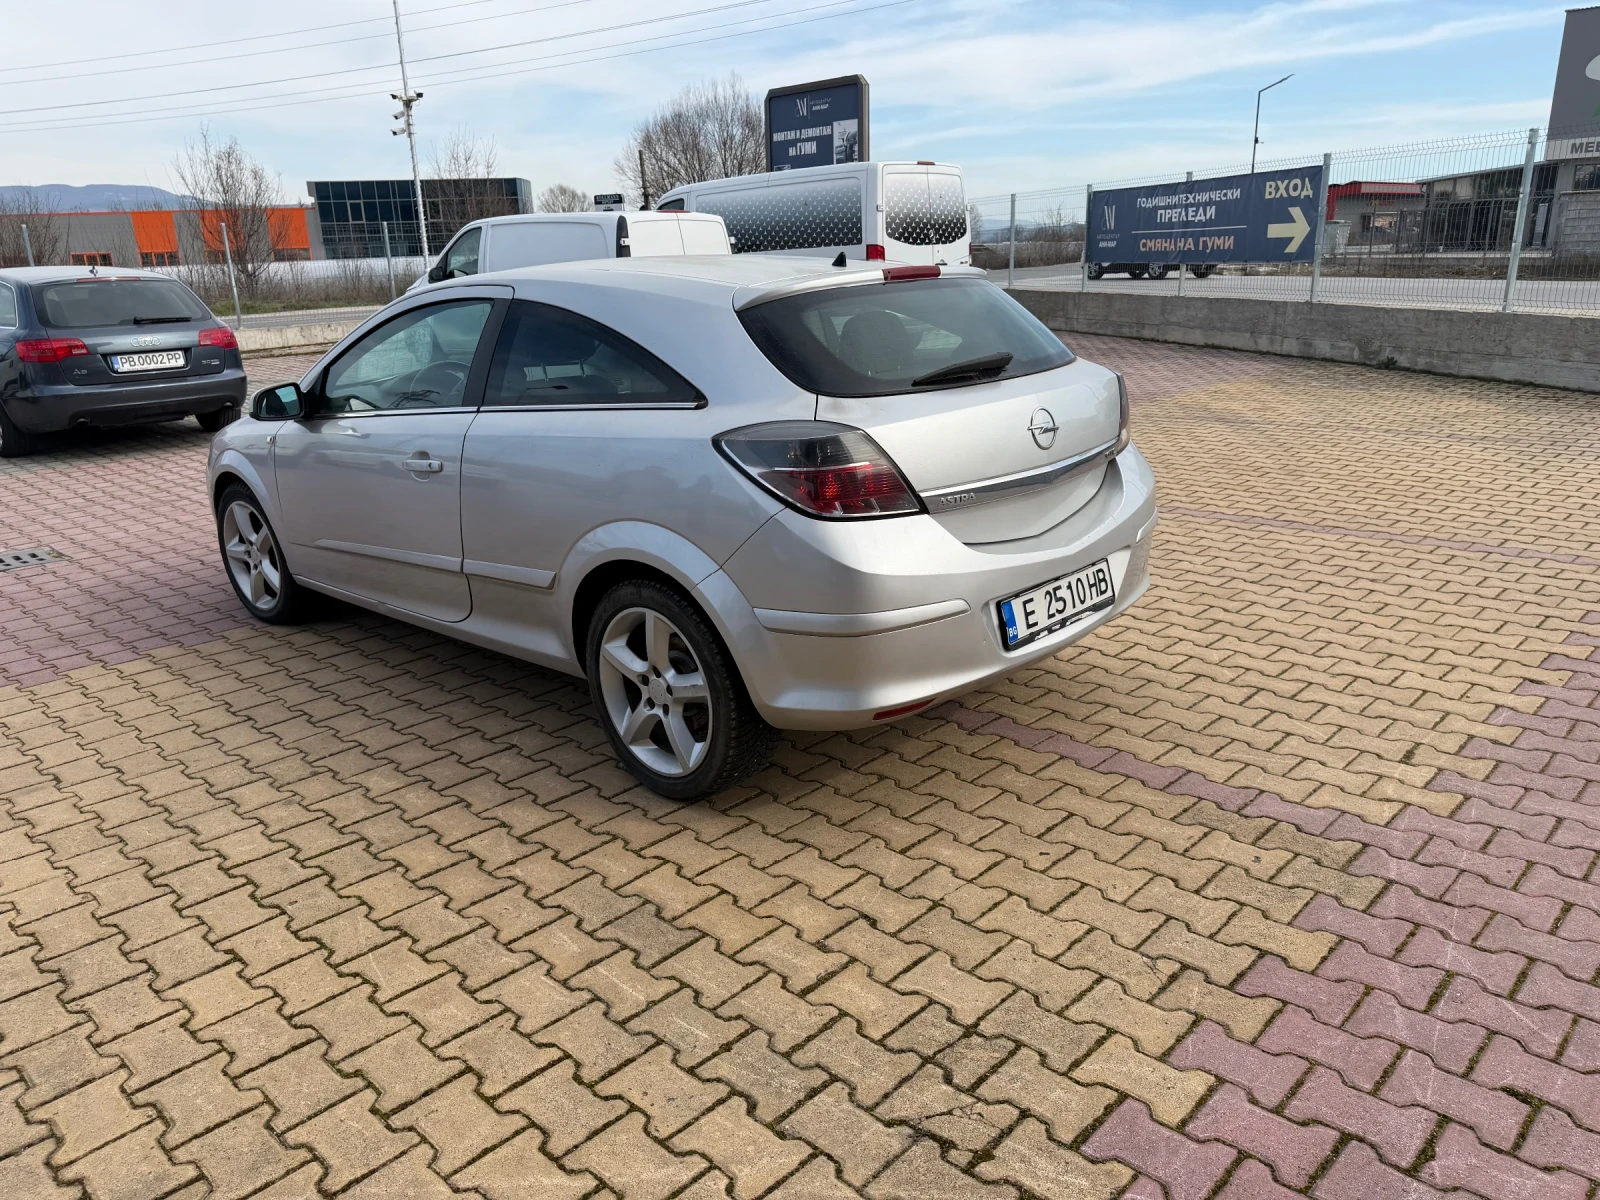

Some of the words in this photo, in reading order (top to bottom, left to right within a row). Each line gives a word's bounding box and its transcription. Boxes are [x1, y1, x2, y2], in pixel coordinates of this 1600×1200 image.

[773, 130, 796, 142] МОНТАЖ
[796, 130, 800, 139] И
[801, 125, 832, 140] ДЕМОНТАЖ
[788, 146, 796, 156] НА
[797, 141, 817, 156] ГУМИ
[1264, 177, 1314, 200] ВХОД
[1139, 238, 1175, 252] СМЯНА
[1176, 237, 1195, 251] НА
[1199, 235, 1235, 253] ГУМИ
[936, 492, 977, 508] ASTRA
[1022, 597, 1039, 630] E
[1008, 627, 1018, 637] BG
